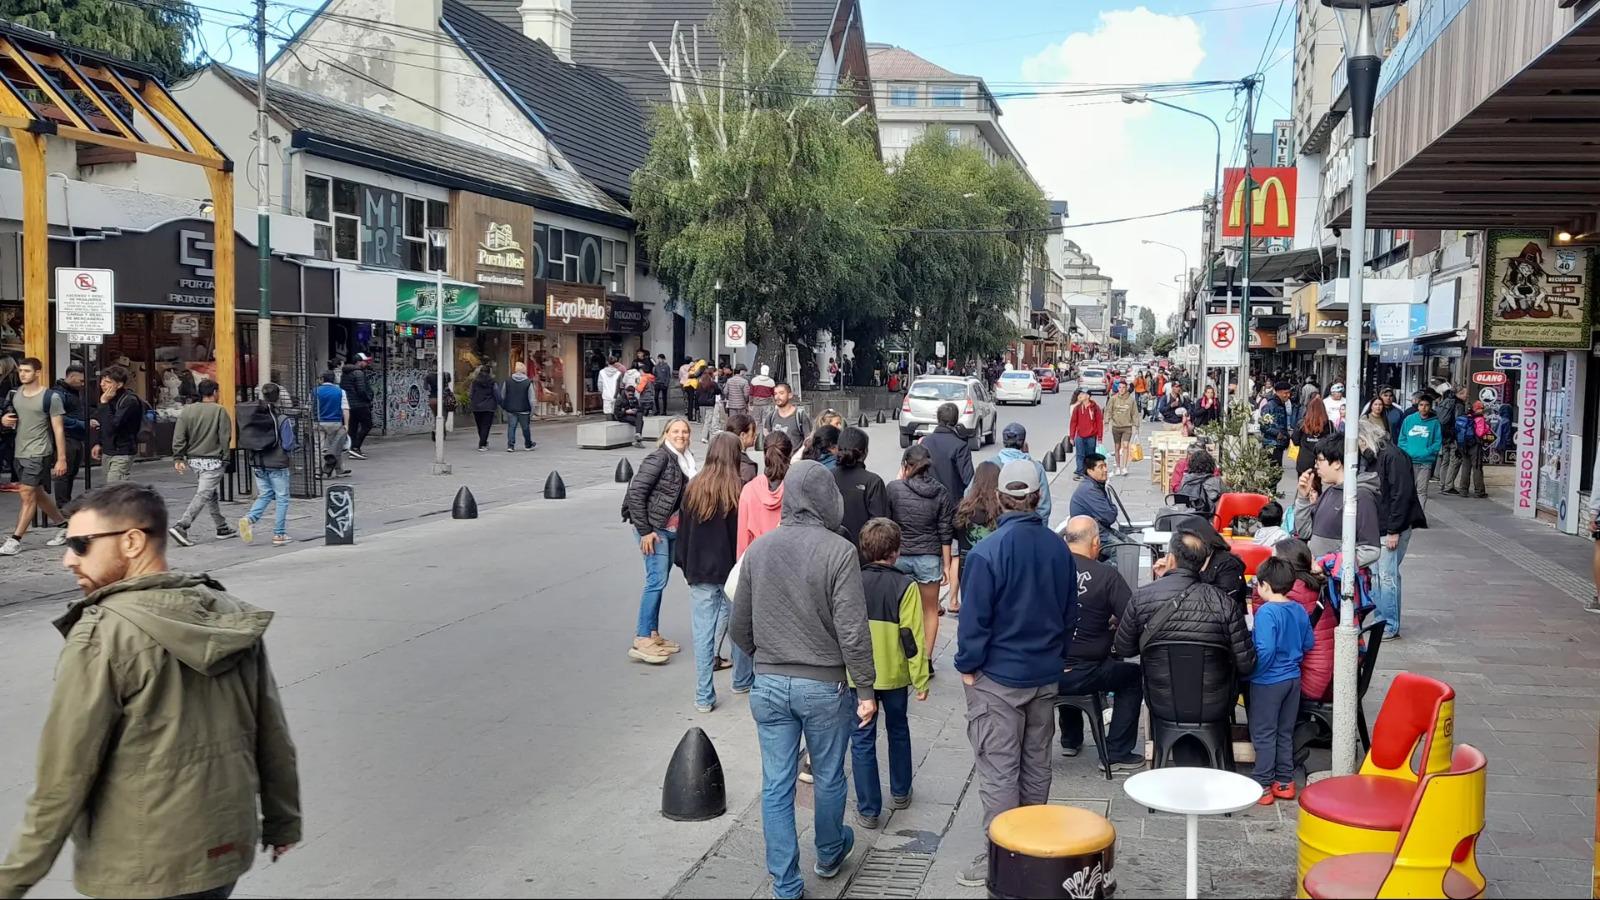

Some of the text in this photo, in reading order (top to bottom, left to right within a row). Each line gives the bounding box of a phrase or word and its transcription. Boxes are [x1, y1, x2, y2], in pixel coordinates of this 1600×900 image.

[549, 294, 577, 324] Lago
[577, 297, 605, 320] Puelo
[1316, 319, 1342, 327] RIP
[1476, 374, 1503, 382] OLANG
[1519, 361, 1539, 509] PASEOS LACUSTRES
